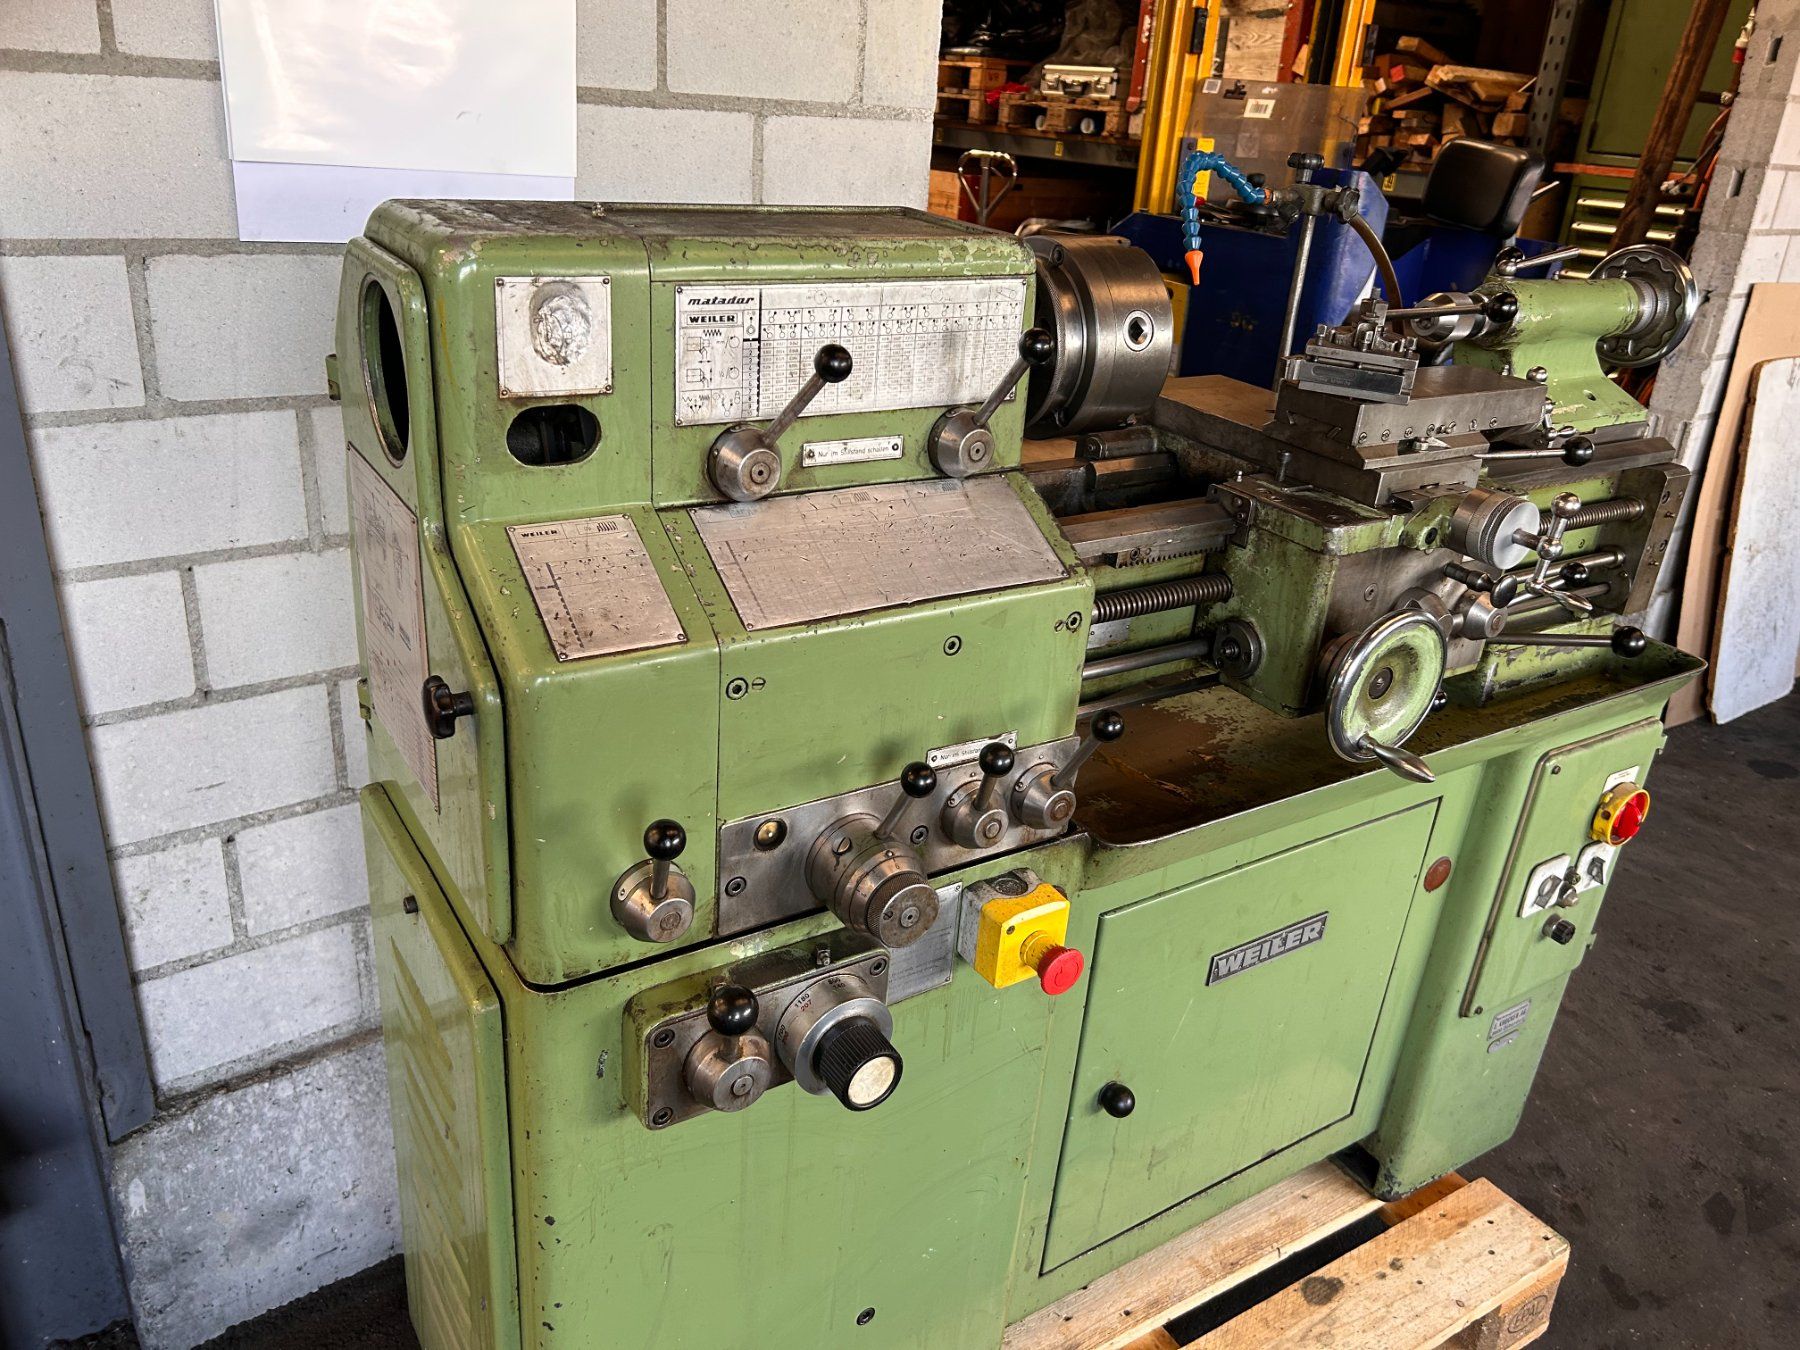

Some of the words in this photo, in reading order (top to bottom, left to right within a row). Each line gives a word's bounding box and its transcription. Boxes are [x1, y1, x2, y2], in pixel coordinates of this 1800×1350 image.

[687, 296, 755, 305] matador
[689, 315, 736, 324] WEILER
[817, 450, 829, 458] Nur
[830, 448, 839, 457] im
[521, 530, 558, 538] WEILER
[1218, 921, 1322, 976] WEILER
[794, 993, 811, 1008] 1180
[800, 1000, 812, 1011] 207
